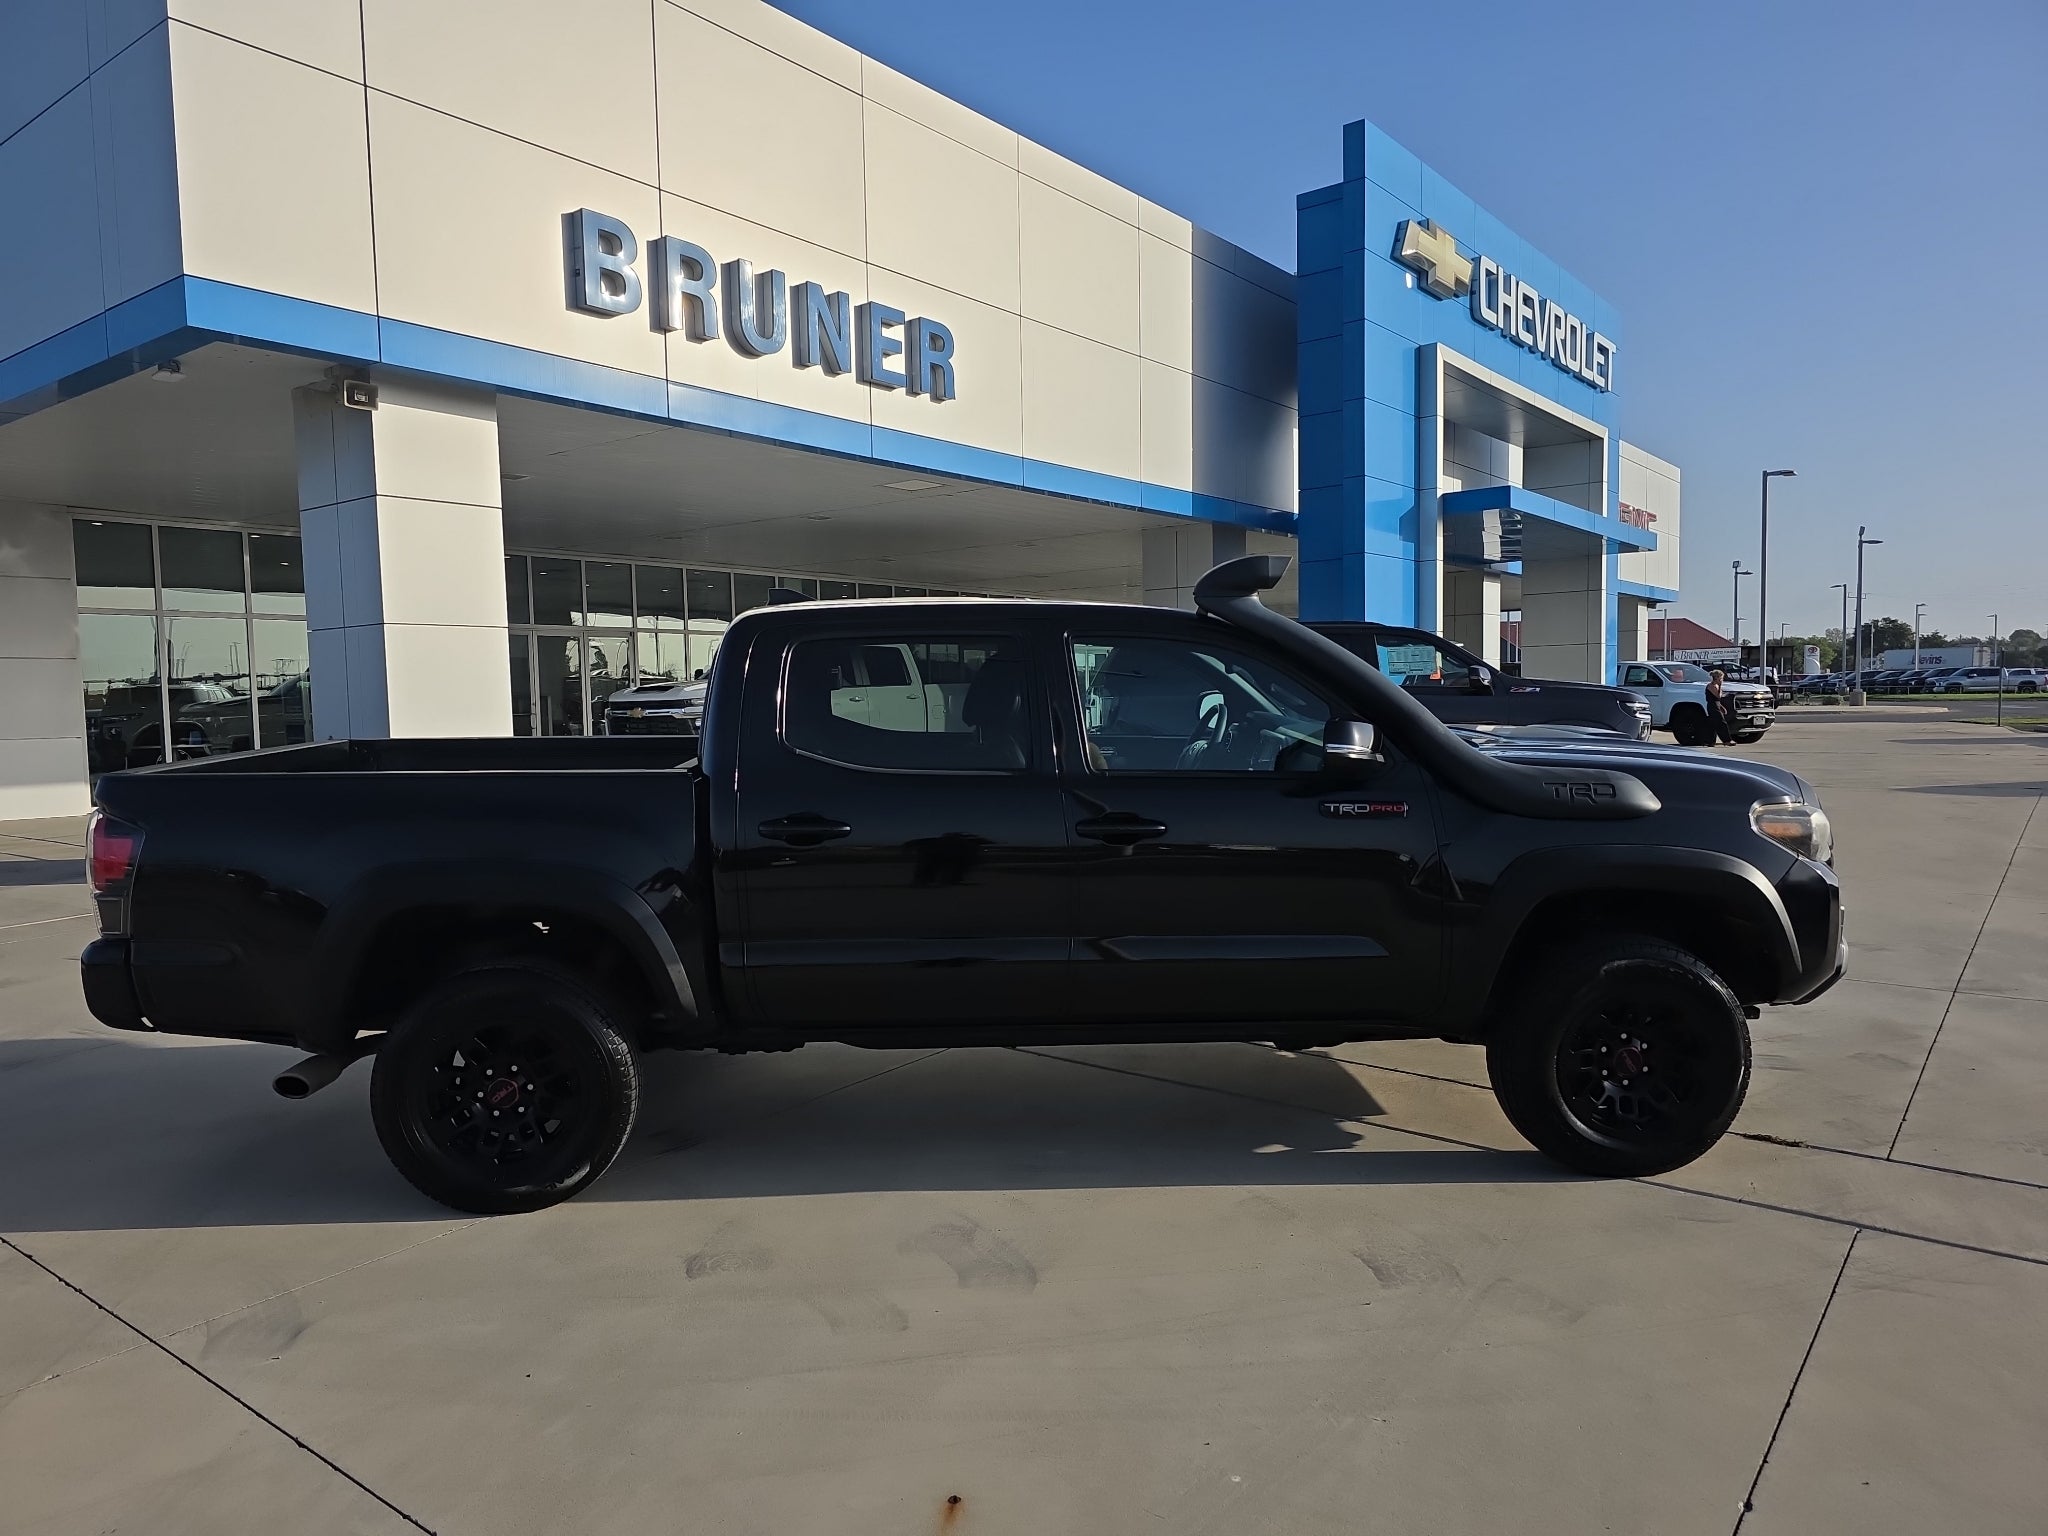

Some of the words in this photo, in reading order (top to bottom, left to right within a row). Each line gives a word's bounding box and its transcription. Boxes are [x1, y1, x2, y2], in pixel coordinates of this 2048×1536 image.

[562, 208, 956, 403] BRUNER
[1473, 255, 1617, 393] CHEVROLET
[1543, 781, 1616, 806] TRD
